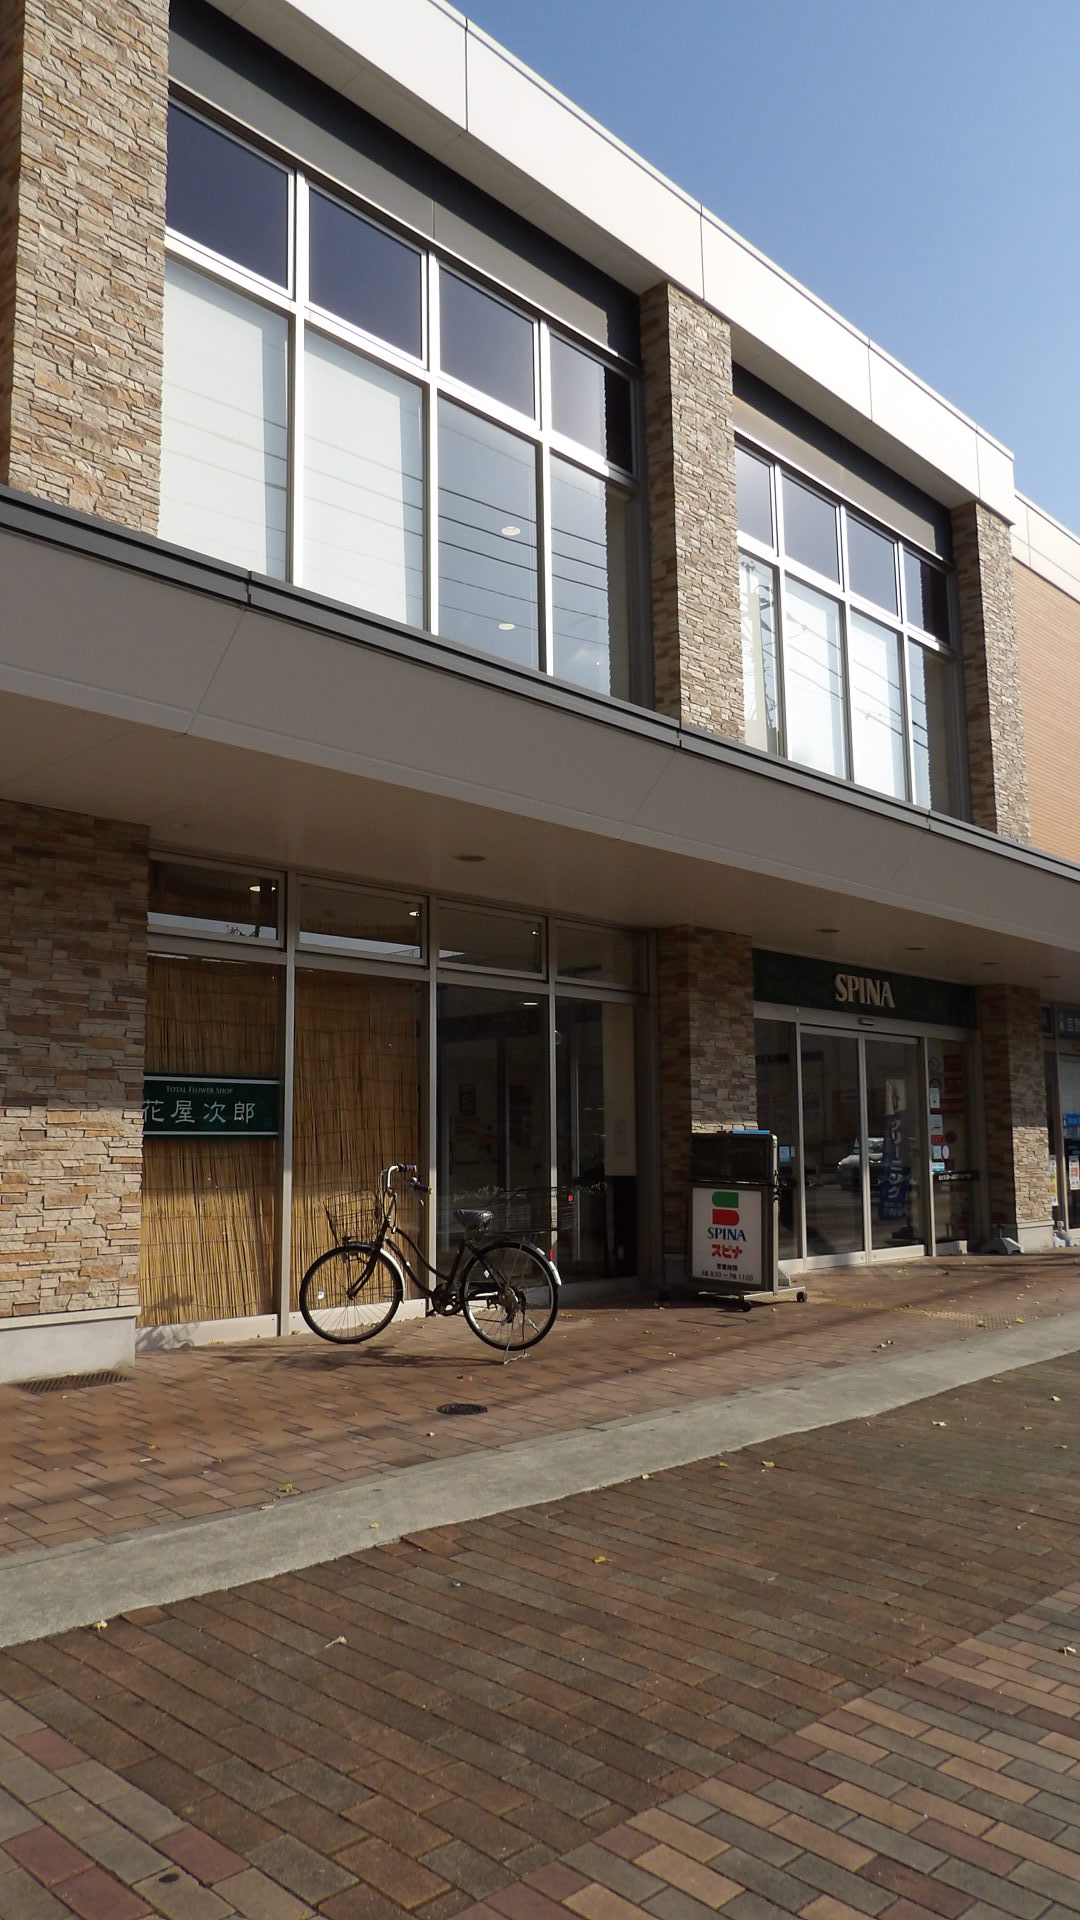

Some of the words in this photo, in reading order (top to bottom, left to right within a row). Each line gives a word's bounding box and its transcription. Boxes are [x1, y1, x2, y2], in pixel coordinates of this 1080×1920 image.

[835, 973, 895, 1008] SPINA
[166, 1085, 185, 1093] TOTAL
[188, 1086, 214, 1094] FLOWER
[215, 1086, 233, 1095] SHOP
[144, 1099, 256, 1124] 花屋次郎
[707, 1226, 747, 1242] SPINA
[711, 1243, 743, 1259] スピナ
